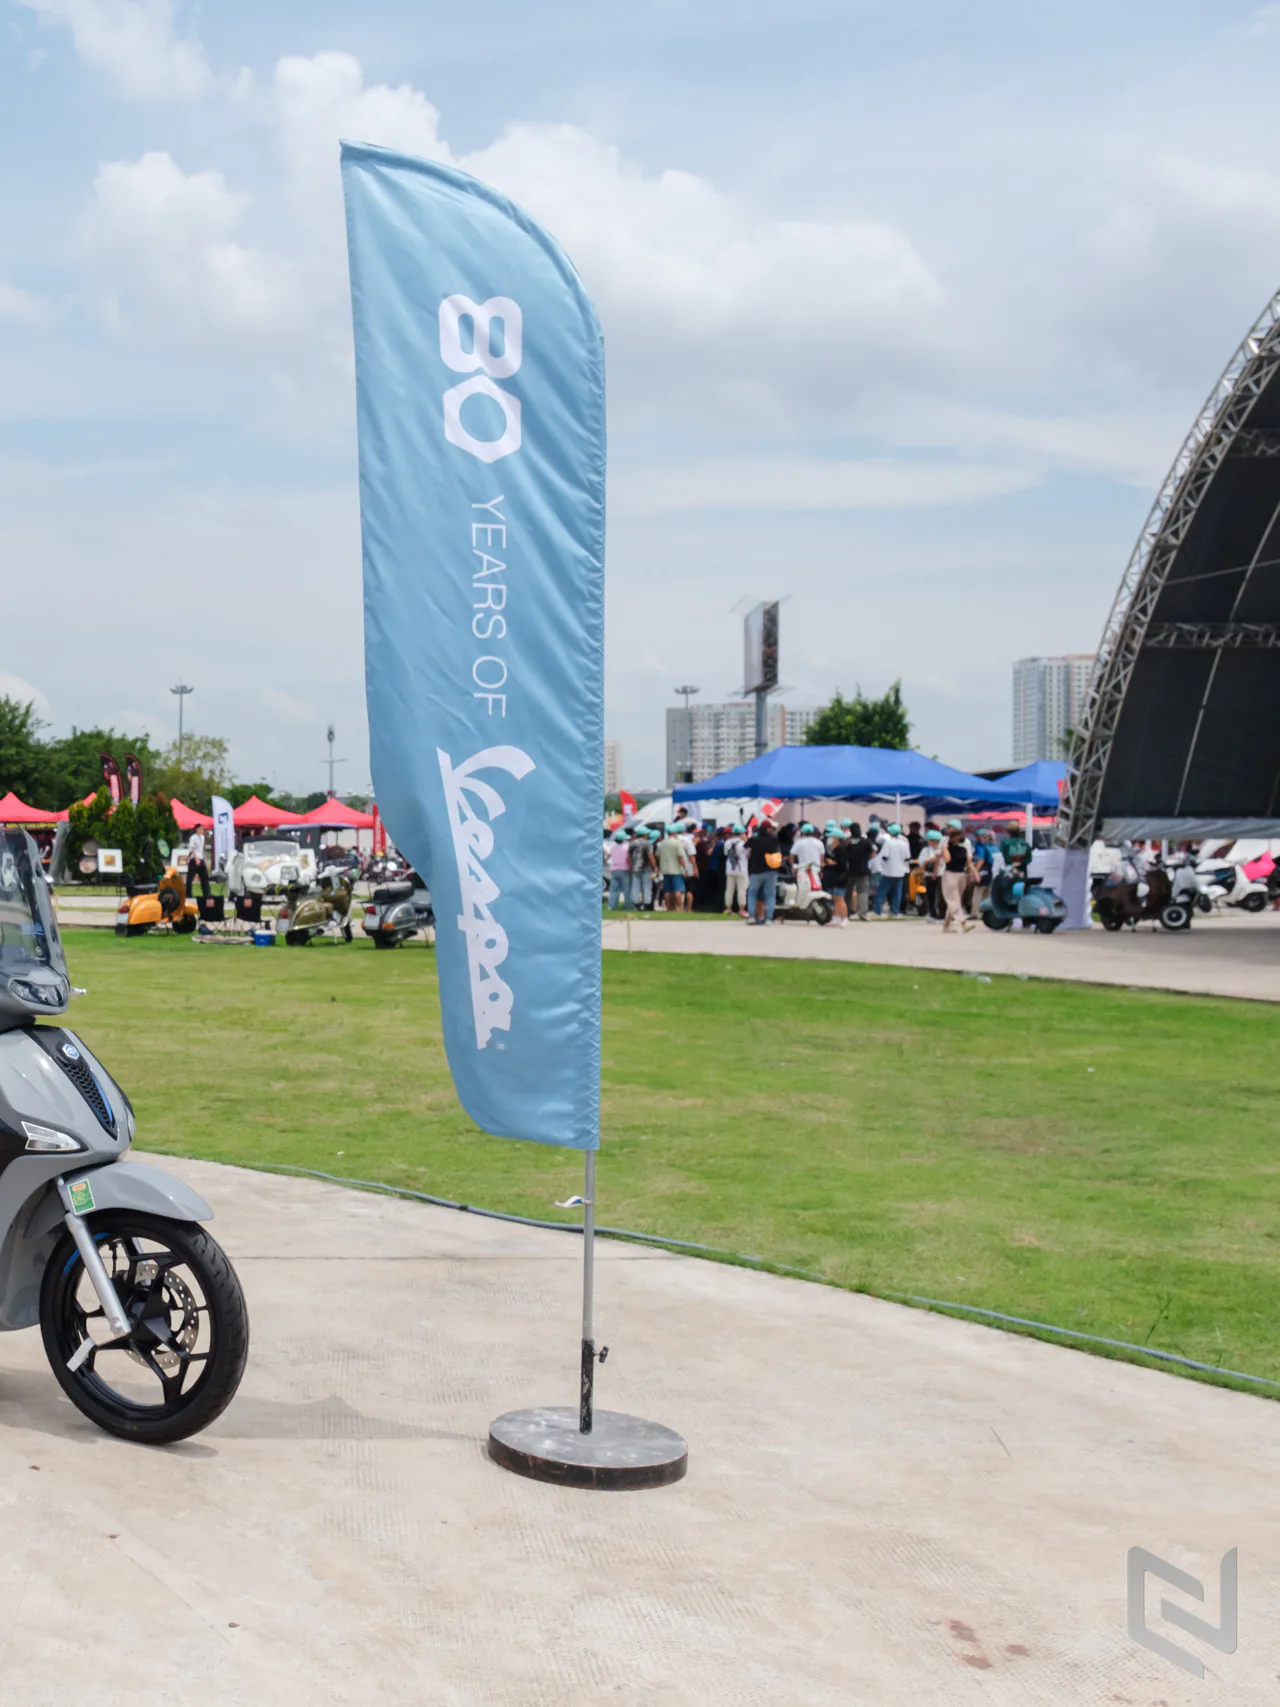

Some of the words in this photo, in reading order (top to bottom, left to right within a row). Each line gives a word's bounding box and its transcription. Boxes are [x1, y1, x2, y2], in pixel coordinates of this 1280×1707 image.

[438, 294, 523, 464] 80
[471, 494, 507, 640] YEARS
[472, 655, 507, 718] OF
[436, 744, 536, 1050] Vespa
